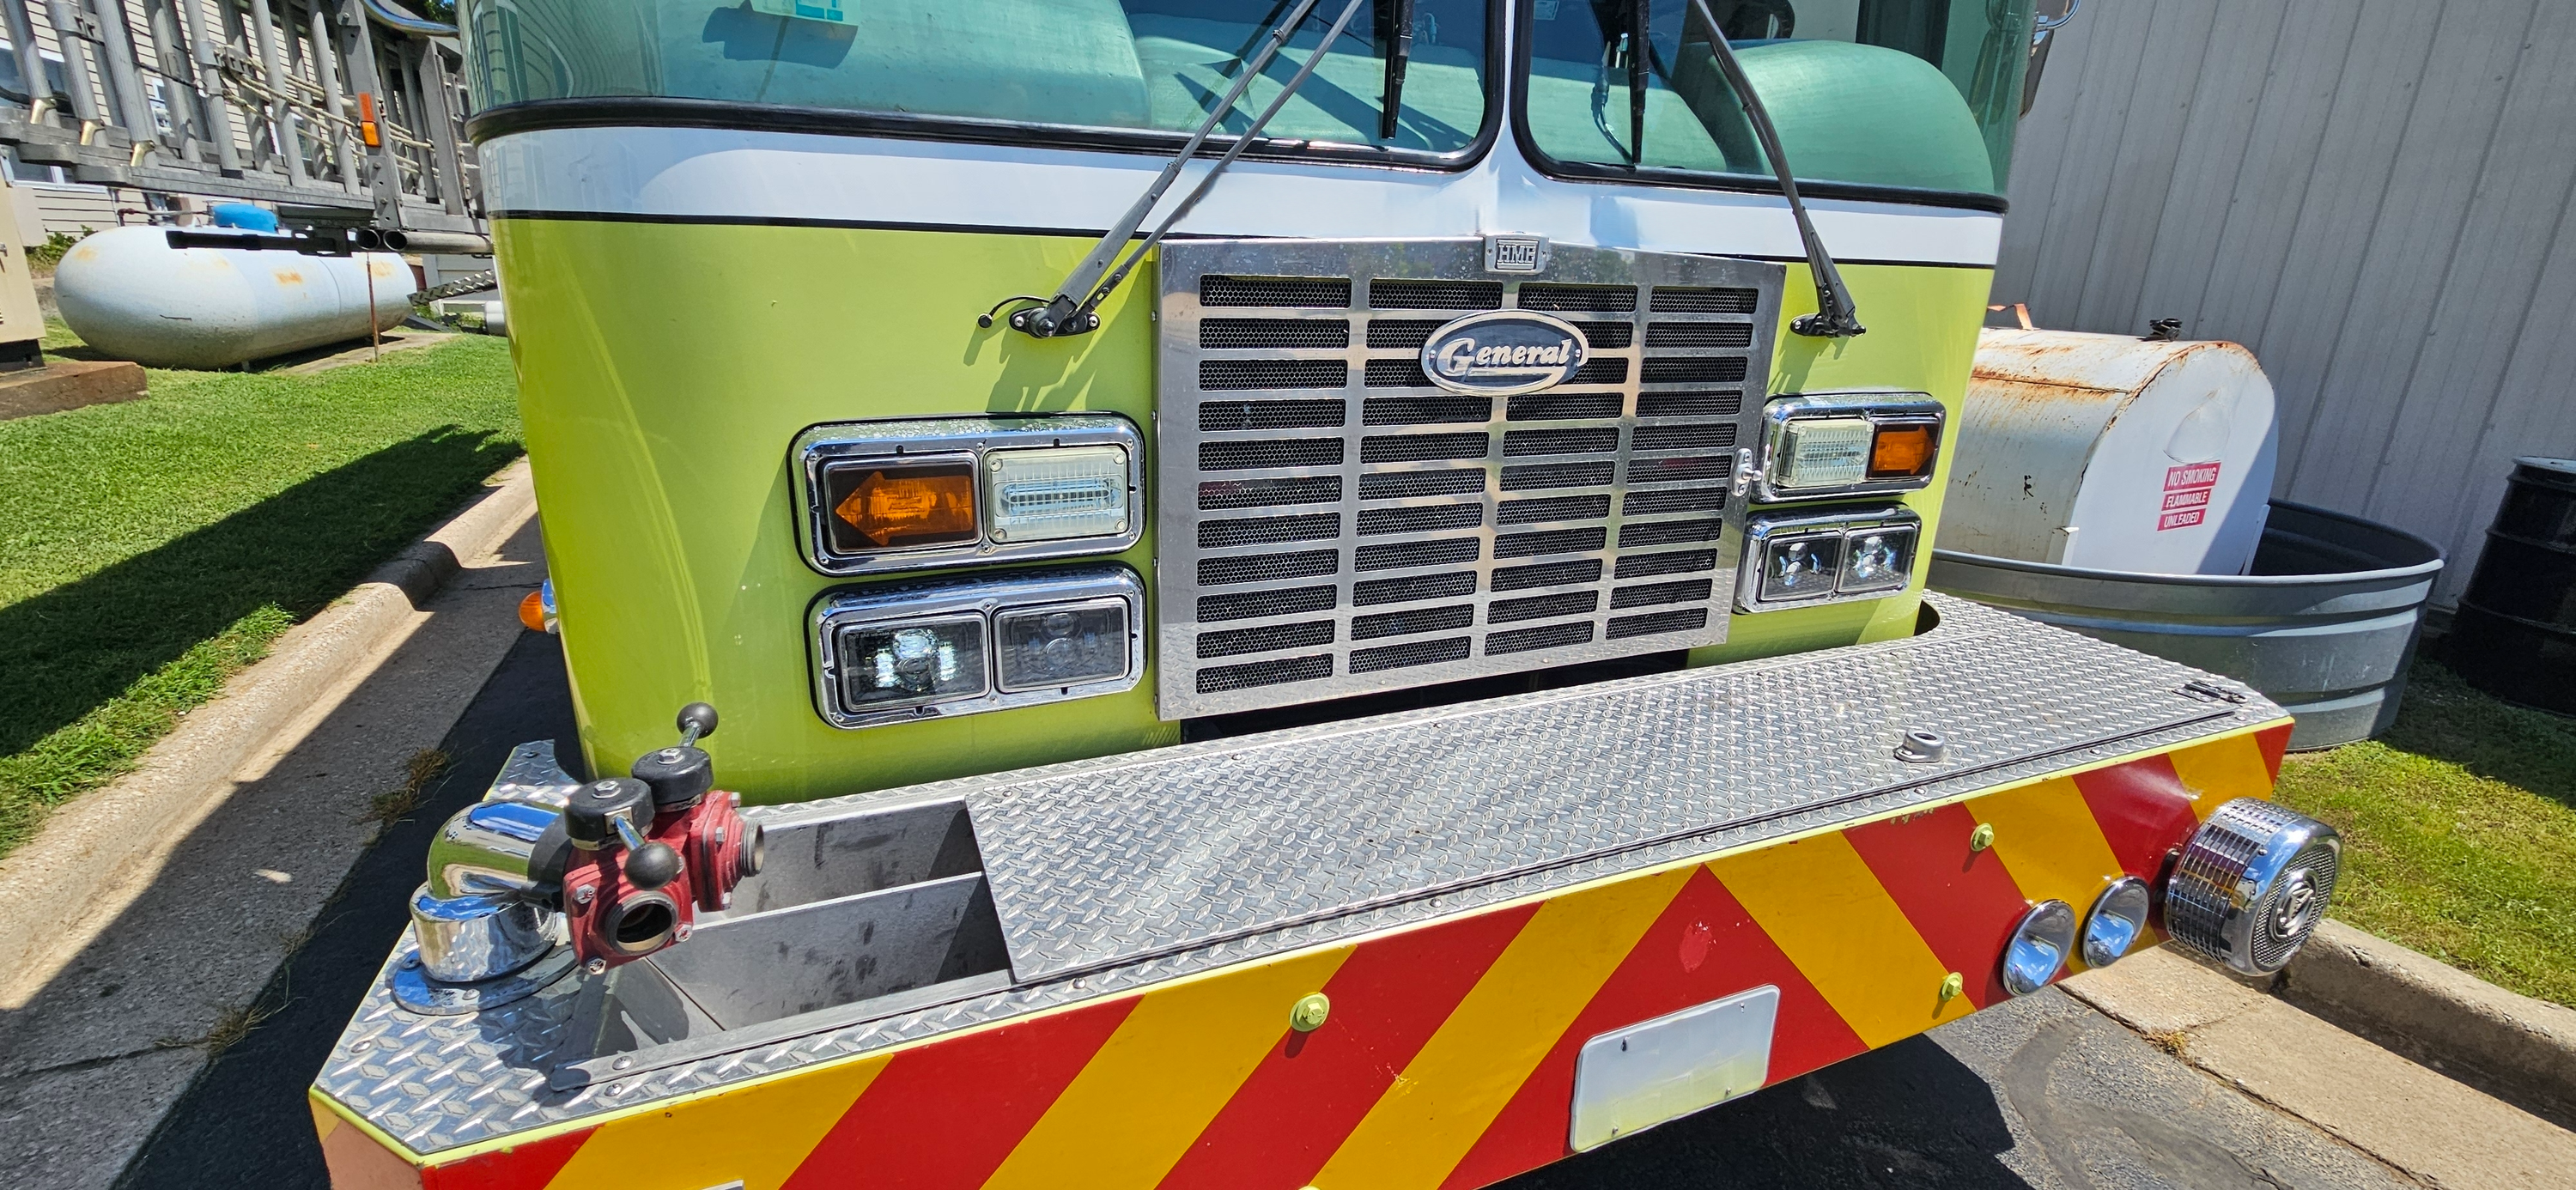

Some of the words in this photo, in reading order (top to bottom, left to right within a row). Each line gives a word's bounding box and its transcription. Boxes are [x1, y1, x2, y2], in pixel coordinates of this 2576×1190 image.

[1436, 338, 1572, 376] General
[2167, 471, 2181, 487] NO
[2181, 467, 2216, 484] SMOKING
[2166, 491, 2208, 507] FLAMMABLE
[2164, 512, 2200, 527] UNLEADED
